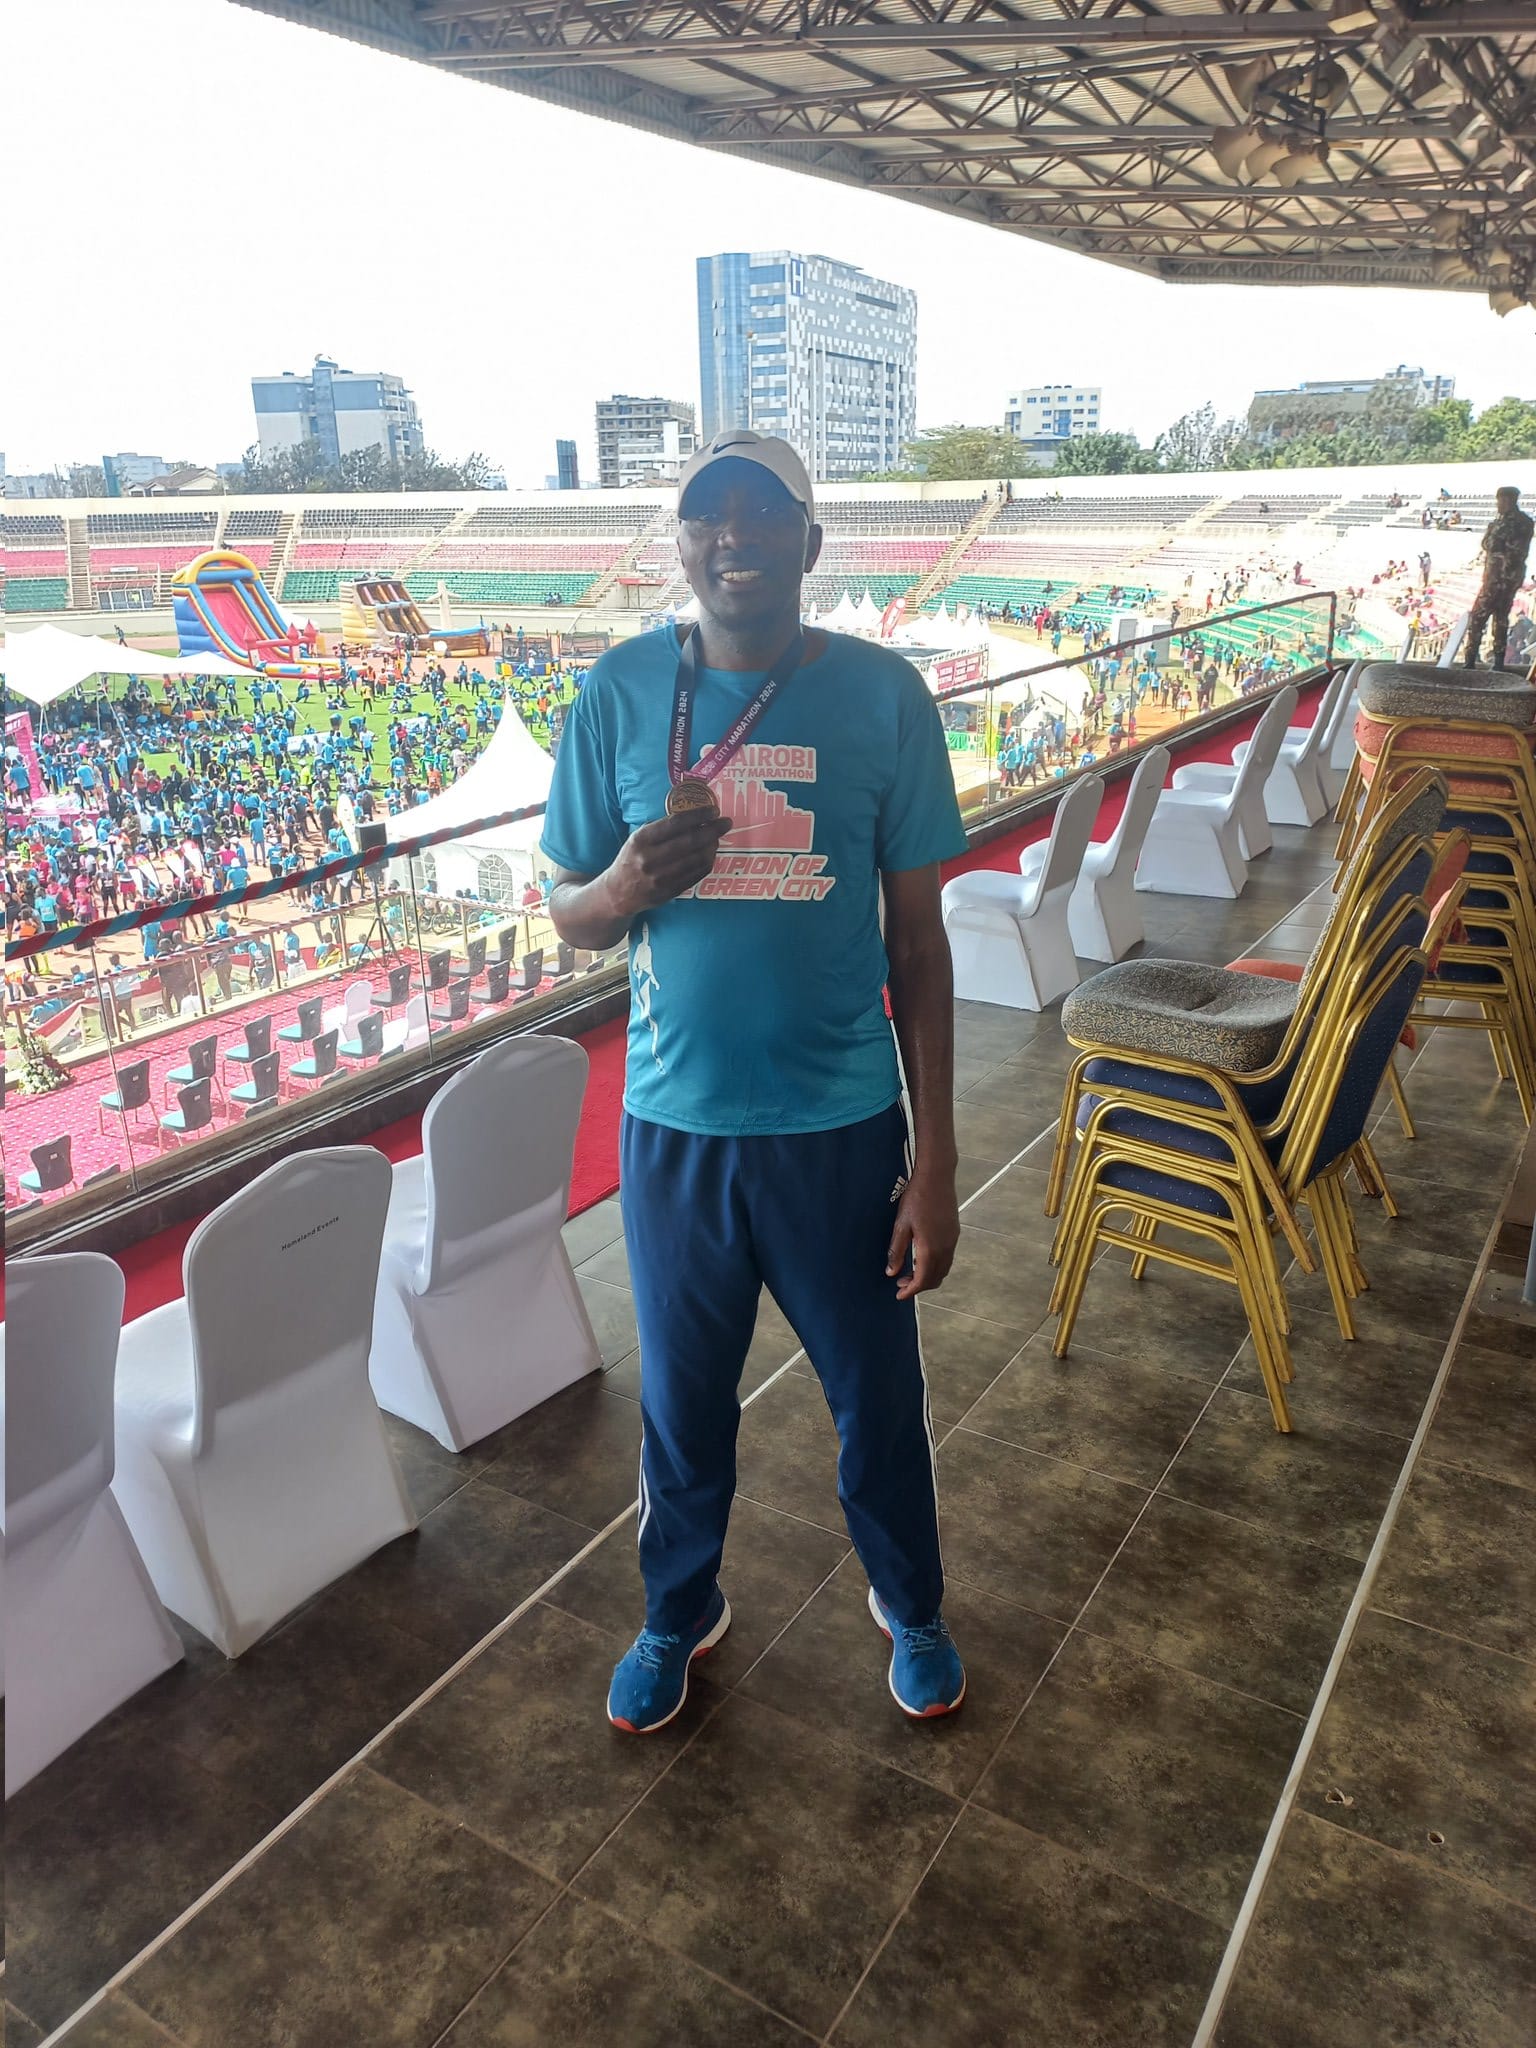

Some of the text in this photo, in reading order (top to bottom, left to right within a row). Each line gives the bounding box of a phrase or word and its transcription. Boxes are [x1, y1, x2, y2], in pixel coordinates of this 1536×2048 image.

[678, 691, 688, 713] 2024
[714, 742, 730, 762] CITY
[728, 701, 763, 746] MARATHON
[759, 680, 777, 702] 2024
[674, 715, 686, 763] MARATHON
[725, 747, 814, 769] AIROBI
[722, 768, 813, 779] CITY MARATHON
[711, 856, 825, 876] MPION OF
[699, 878, 781, 897] GREEN
[782, 879, 833, 897] CITY
[282, 1216, 339, 1251] Homeland Events
